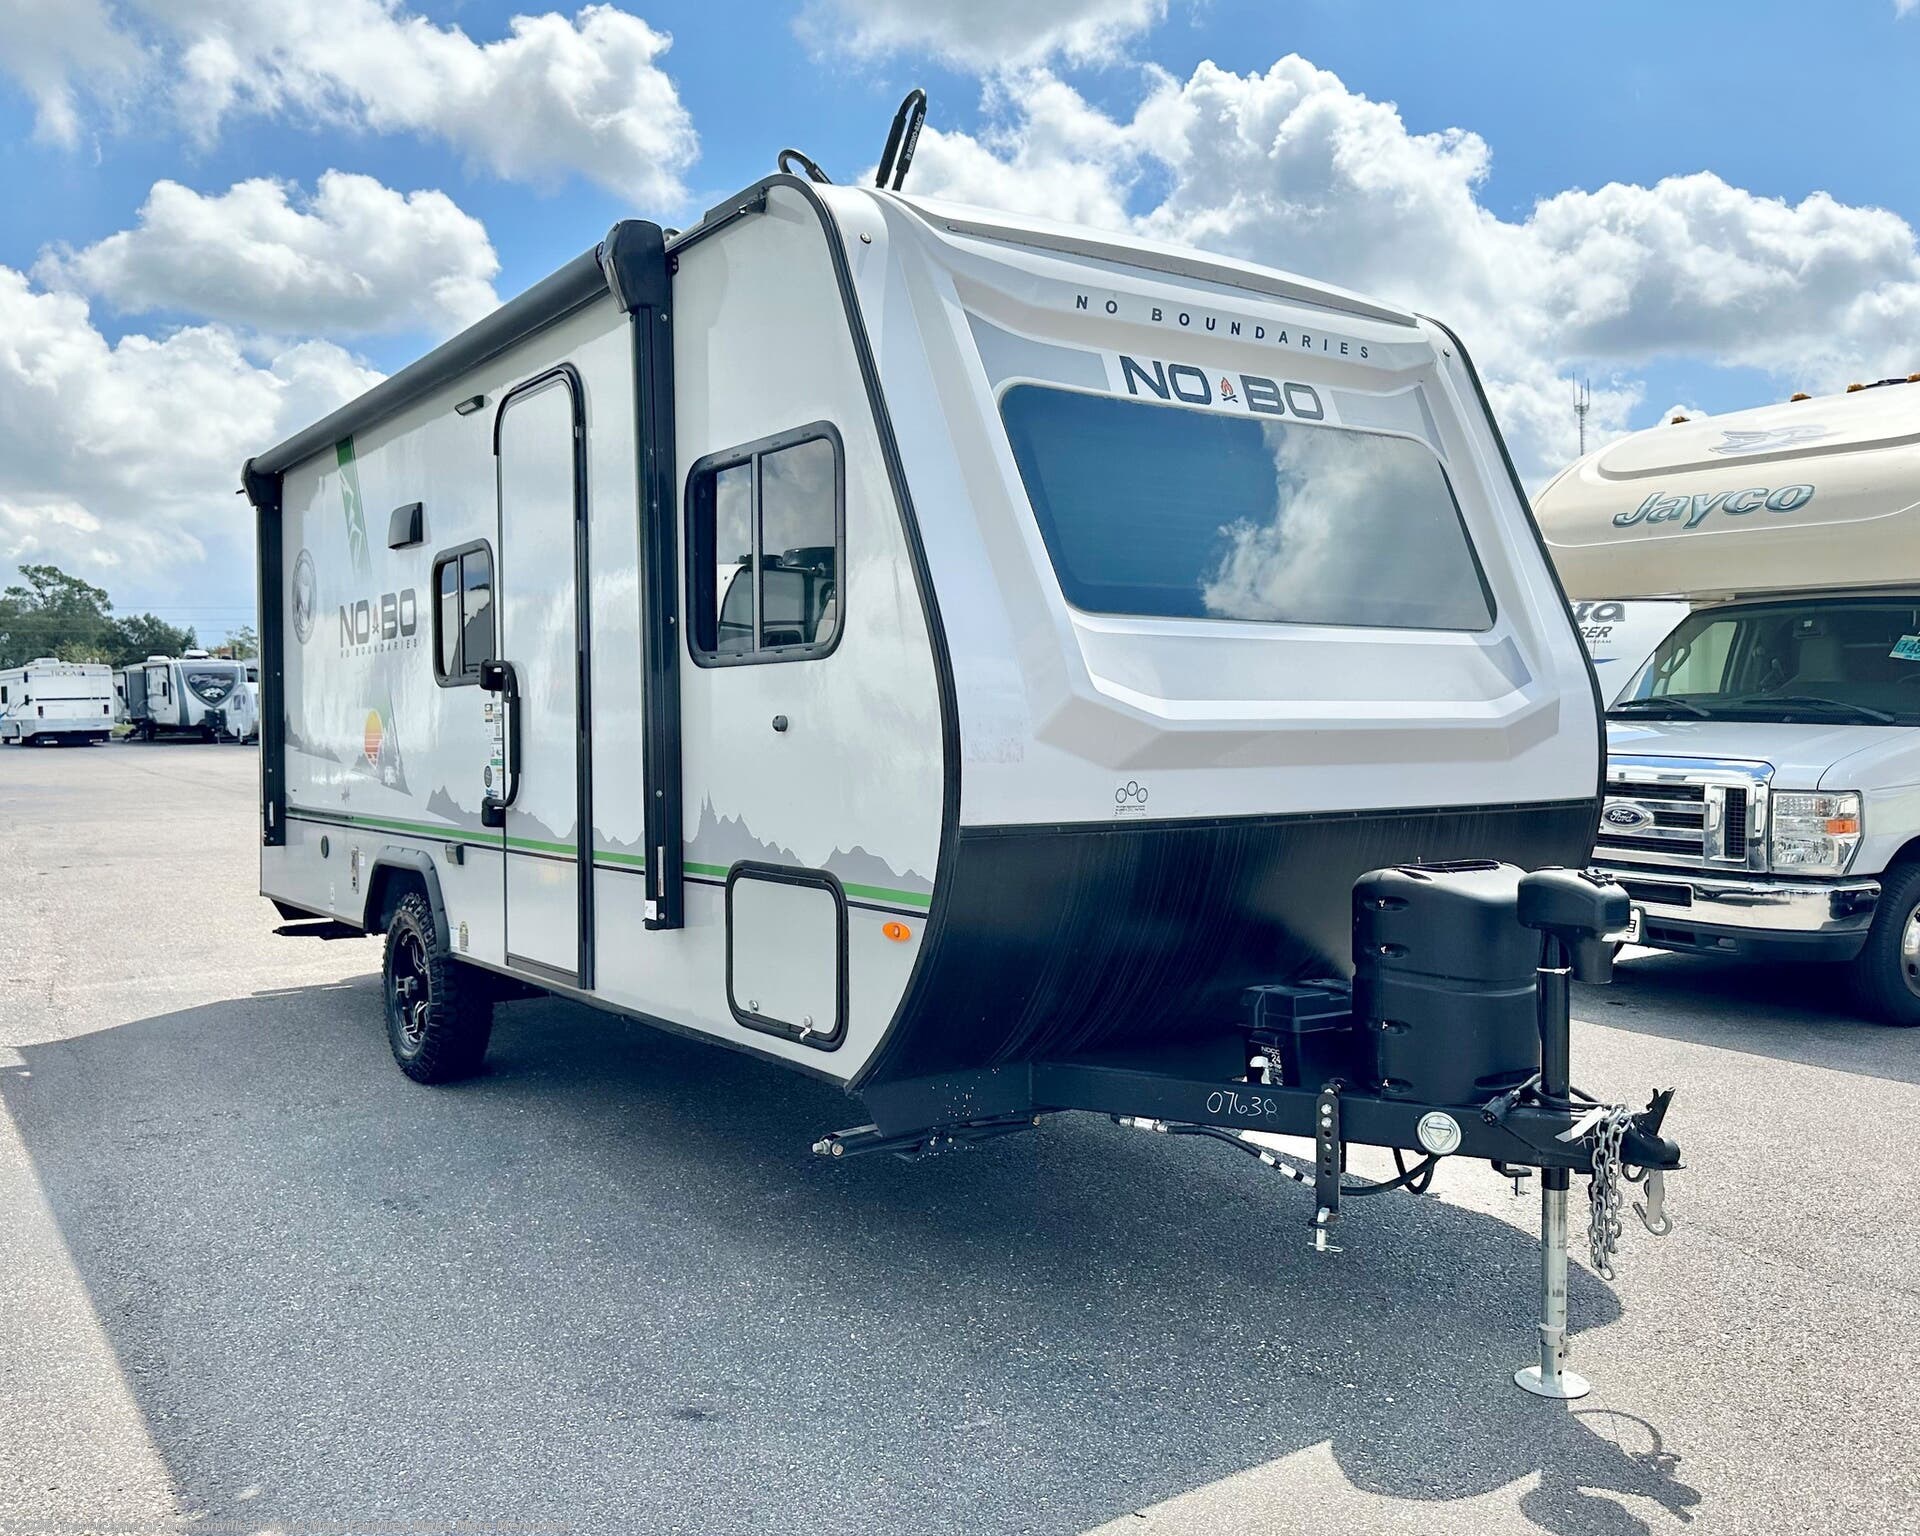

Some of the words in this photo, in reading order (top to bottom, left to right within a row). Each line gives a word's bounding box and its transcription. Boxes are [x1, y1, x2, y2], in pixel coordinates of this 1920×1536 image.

[1076, 294, 1118, 314] NO
[1151, 306, 1369, 359] BOUNDARIES
[1612, 484, 1815, 529] Jayco
[1571, 602, 1626, 623] ta
[1610, 809, 1634, 823] Ford
[1206, 1090, 1278, 1123] 07638
